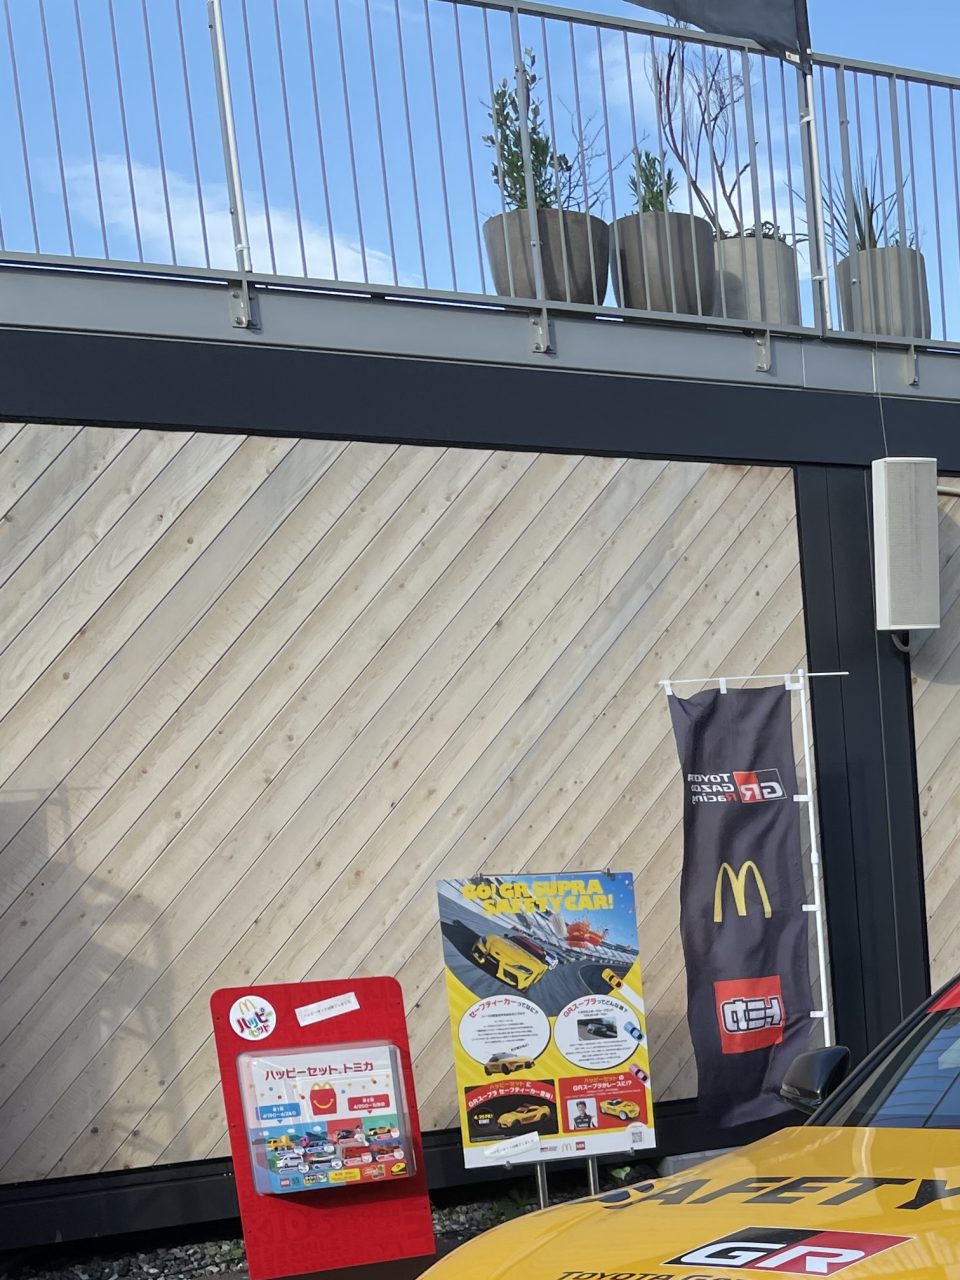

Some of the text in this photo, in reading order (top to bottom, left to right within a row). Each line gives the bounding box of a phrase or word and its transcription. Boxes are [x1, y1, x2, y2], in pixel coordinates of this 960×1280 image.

[462, 879, 604, 900] GO! GR SUPRA
[482, 894, 614, 916] SAFETY CAR!
[343, 1061, 374, 1074] トミカ
[681, 1241, 866, 1273] GR
